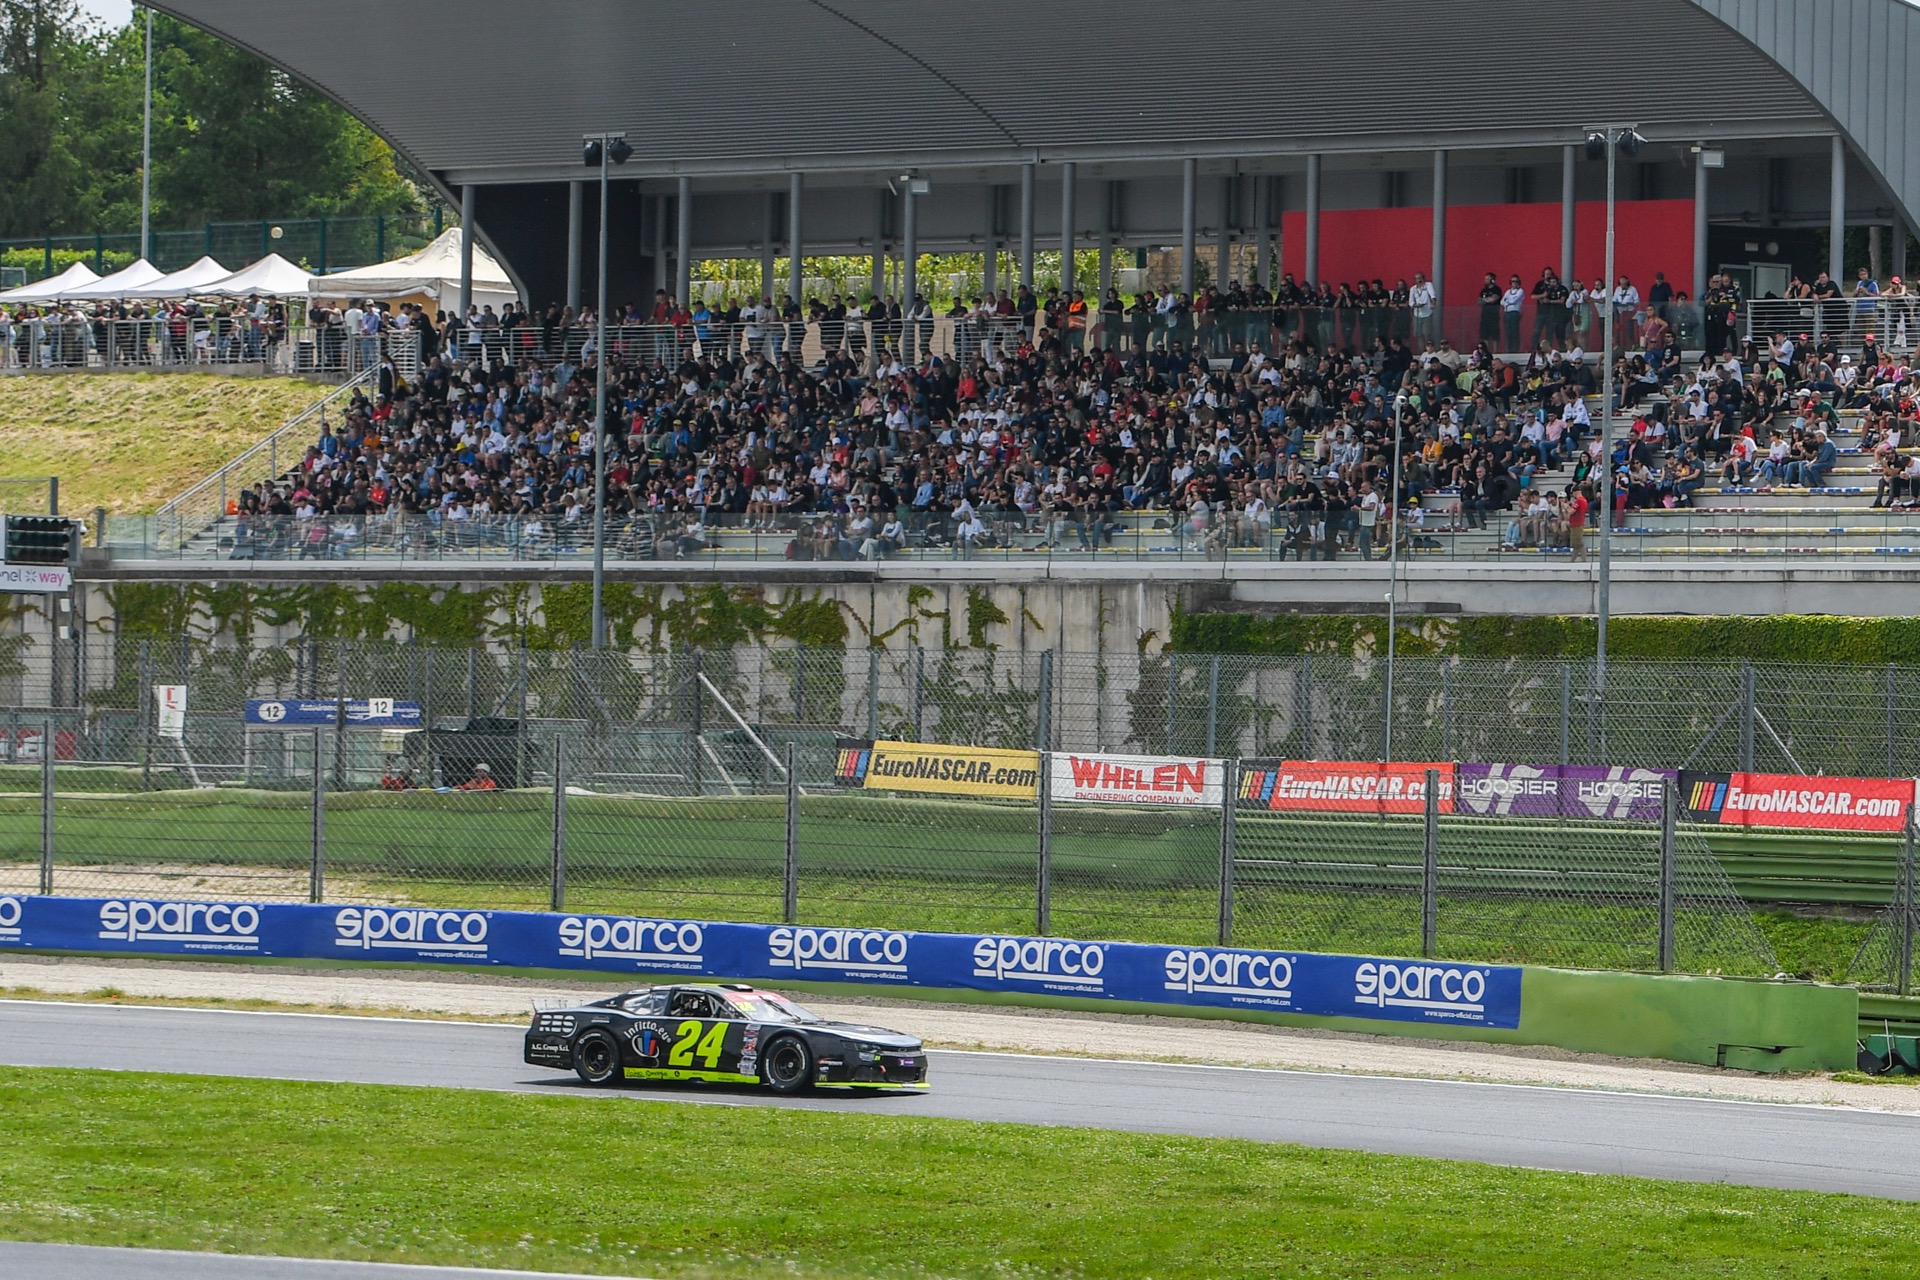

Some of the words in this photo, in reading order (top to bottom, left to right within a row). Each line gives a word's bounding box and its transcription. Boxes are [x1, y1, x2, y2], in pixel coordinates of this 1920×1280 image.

[0, 569, 22, 582] nel
[39, 572, 65, 586] way
[265, 705, 280, 718] 12
[374, 701, 388, 714] 12
[872, 754, 1037, 787] EuroNASCAR.com
[1070, 755, 1206, 793] WHELEN
[1461, 779, 1558, 795] HOOSIER
[1579, 782, 1662, 798] HOOSIE
[1075, 792, 1133, 802] ENGINEERING
[1136, 794, 1181, 804] COMPANY
[1727, 788, 1901, 817] EuroNASCAR.com
[100, 901, 260, 942] sparco
[335, 908, 488, 950] sparco
[184, 943, 259, 951] www.sparco-official.com
[558, 917, 703, 960] sparco
[418, 951, 487, 959] www.sparco-official.com
[769, 928, 908, 970] sparco
[636, 961, 703, 970] www.sparco-official.com
[973, 938, 1104, 981] sparco
[845, 971, 908, 980] www.sparco-official.com
[1165, 950, 1292, 994] sparco
[1043, 983, 1104, 992] www.sparco-official.com
[1355, 963, 1485, 1008] sparco
[1232, 997, 1291, 1006] www.sparco-official.com
[1424, 1010, 1484, 1020] www.sparco-official.com
[623, 1021, 669, 1041] Infitto.eu
[668, 1020, 729, 1068] 24
